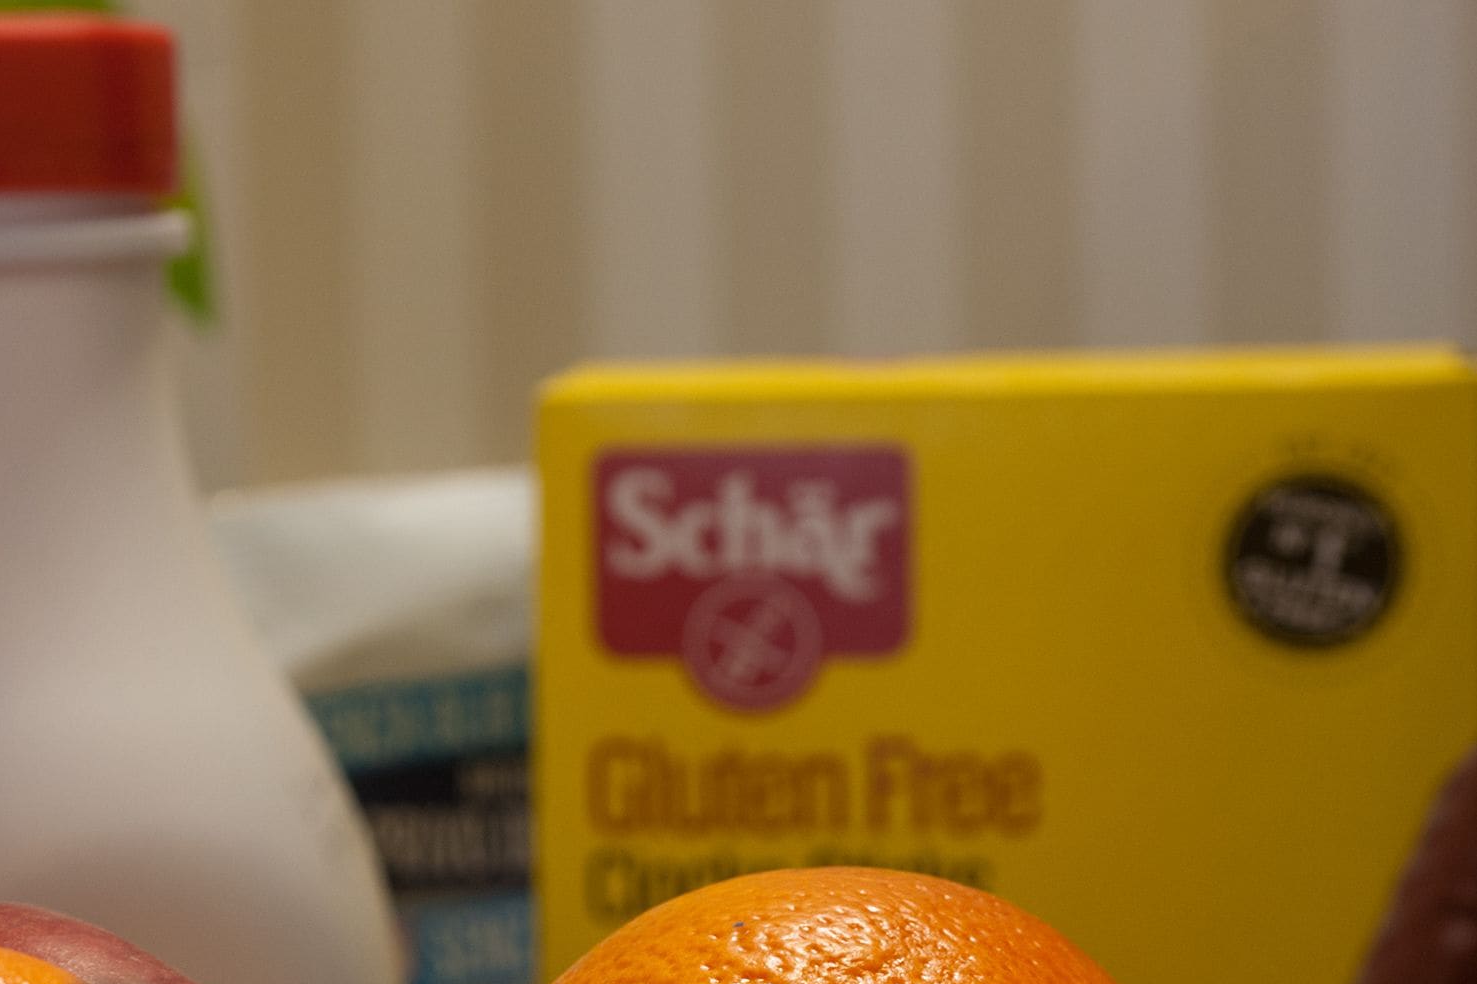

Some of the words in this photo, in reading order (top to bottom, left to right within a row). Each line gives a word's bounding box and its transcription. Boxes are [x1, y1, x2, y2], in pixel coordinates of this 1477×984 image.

[603, 467, 898, 602] Schär
[586, 736, 851, 839] Gluten
[864, 735, 1042, 840] Free
